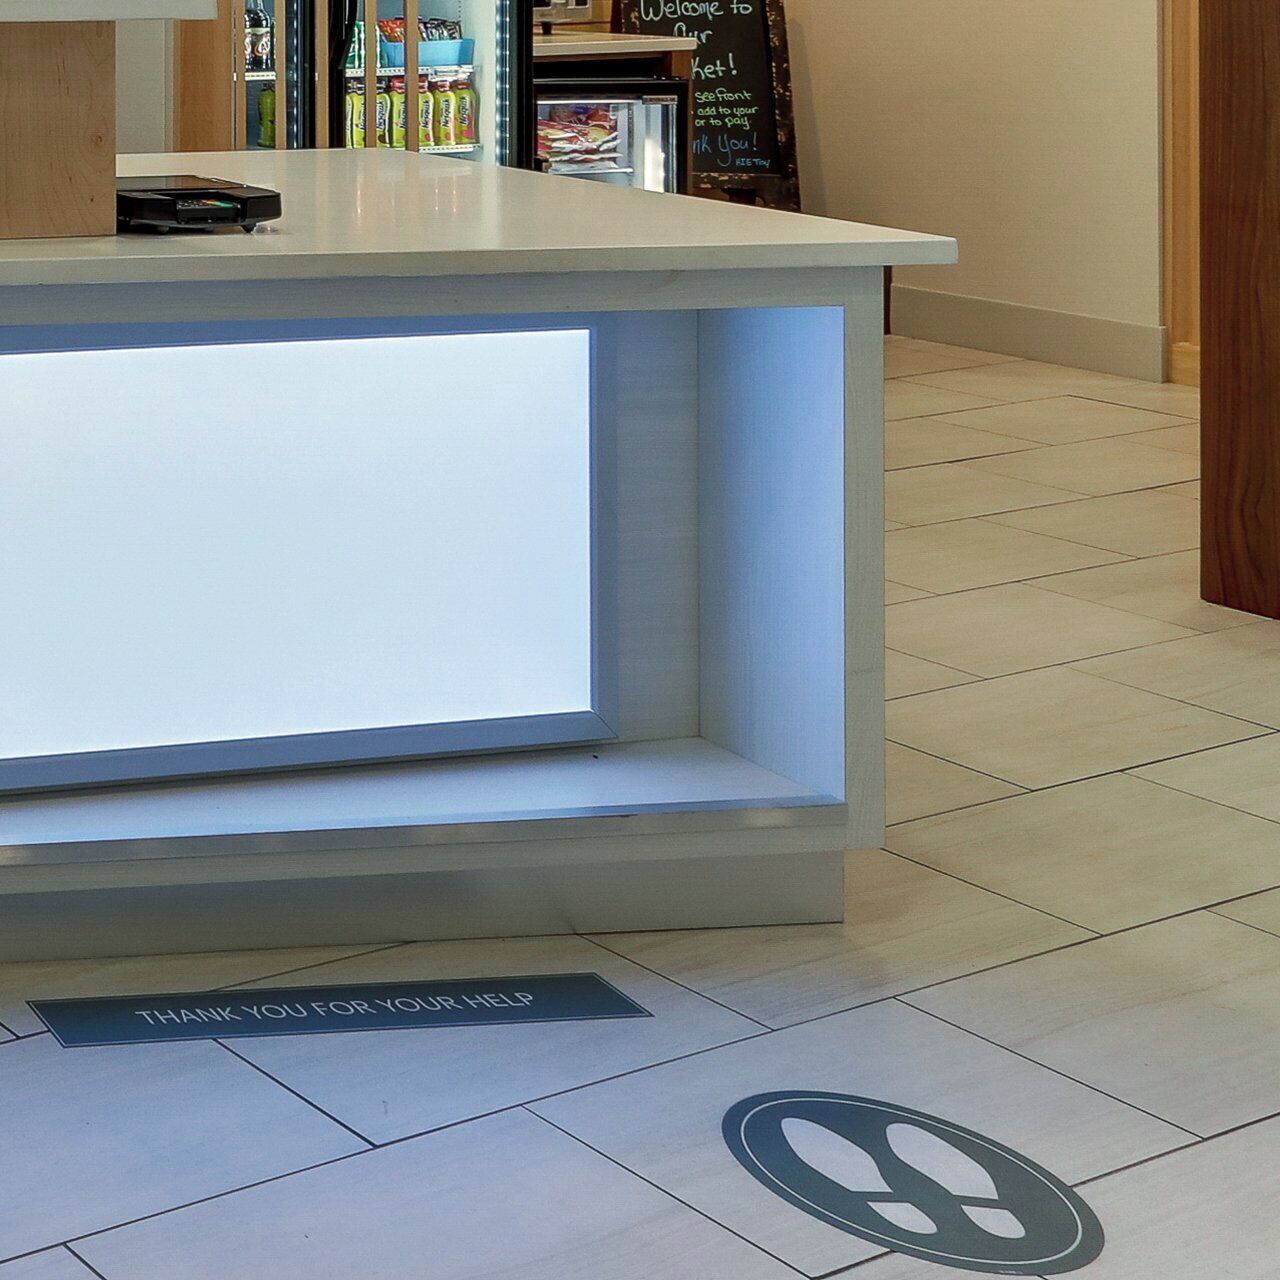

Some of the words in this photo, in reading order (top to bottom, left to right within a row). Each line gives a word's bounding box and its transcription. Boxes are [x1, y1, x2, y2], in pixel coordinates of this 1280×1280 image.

[695, 92, 716, 102] see
[716, 88, 752, 101] front
[697, 107, 716, 116] add
[719, 106, 731, 115] to
[733, 106, 759, 116] your
[709, 118, 722, 126] to
[135, 1006, 242, 1026] THANK
[241, 1003, 308, 1020] YOU
[311, 999, 377, 1017] FOR
[375, 996, 463, 1013] YOUR
[462, 992, 534, 1009] HELP
